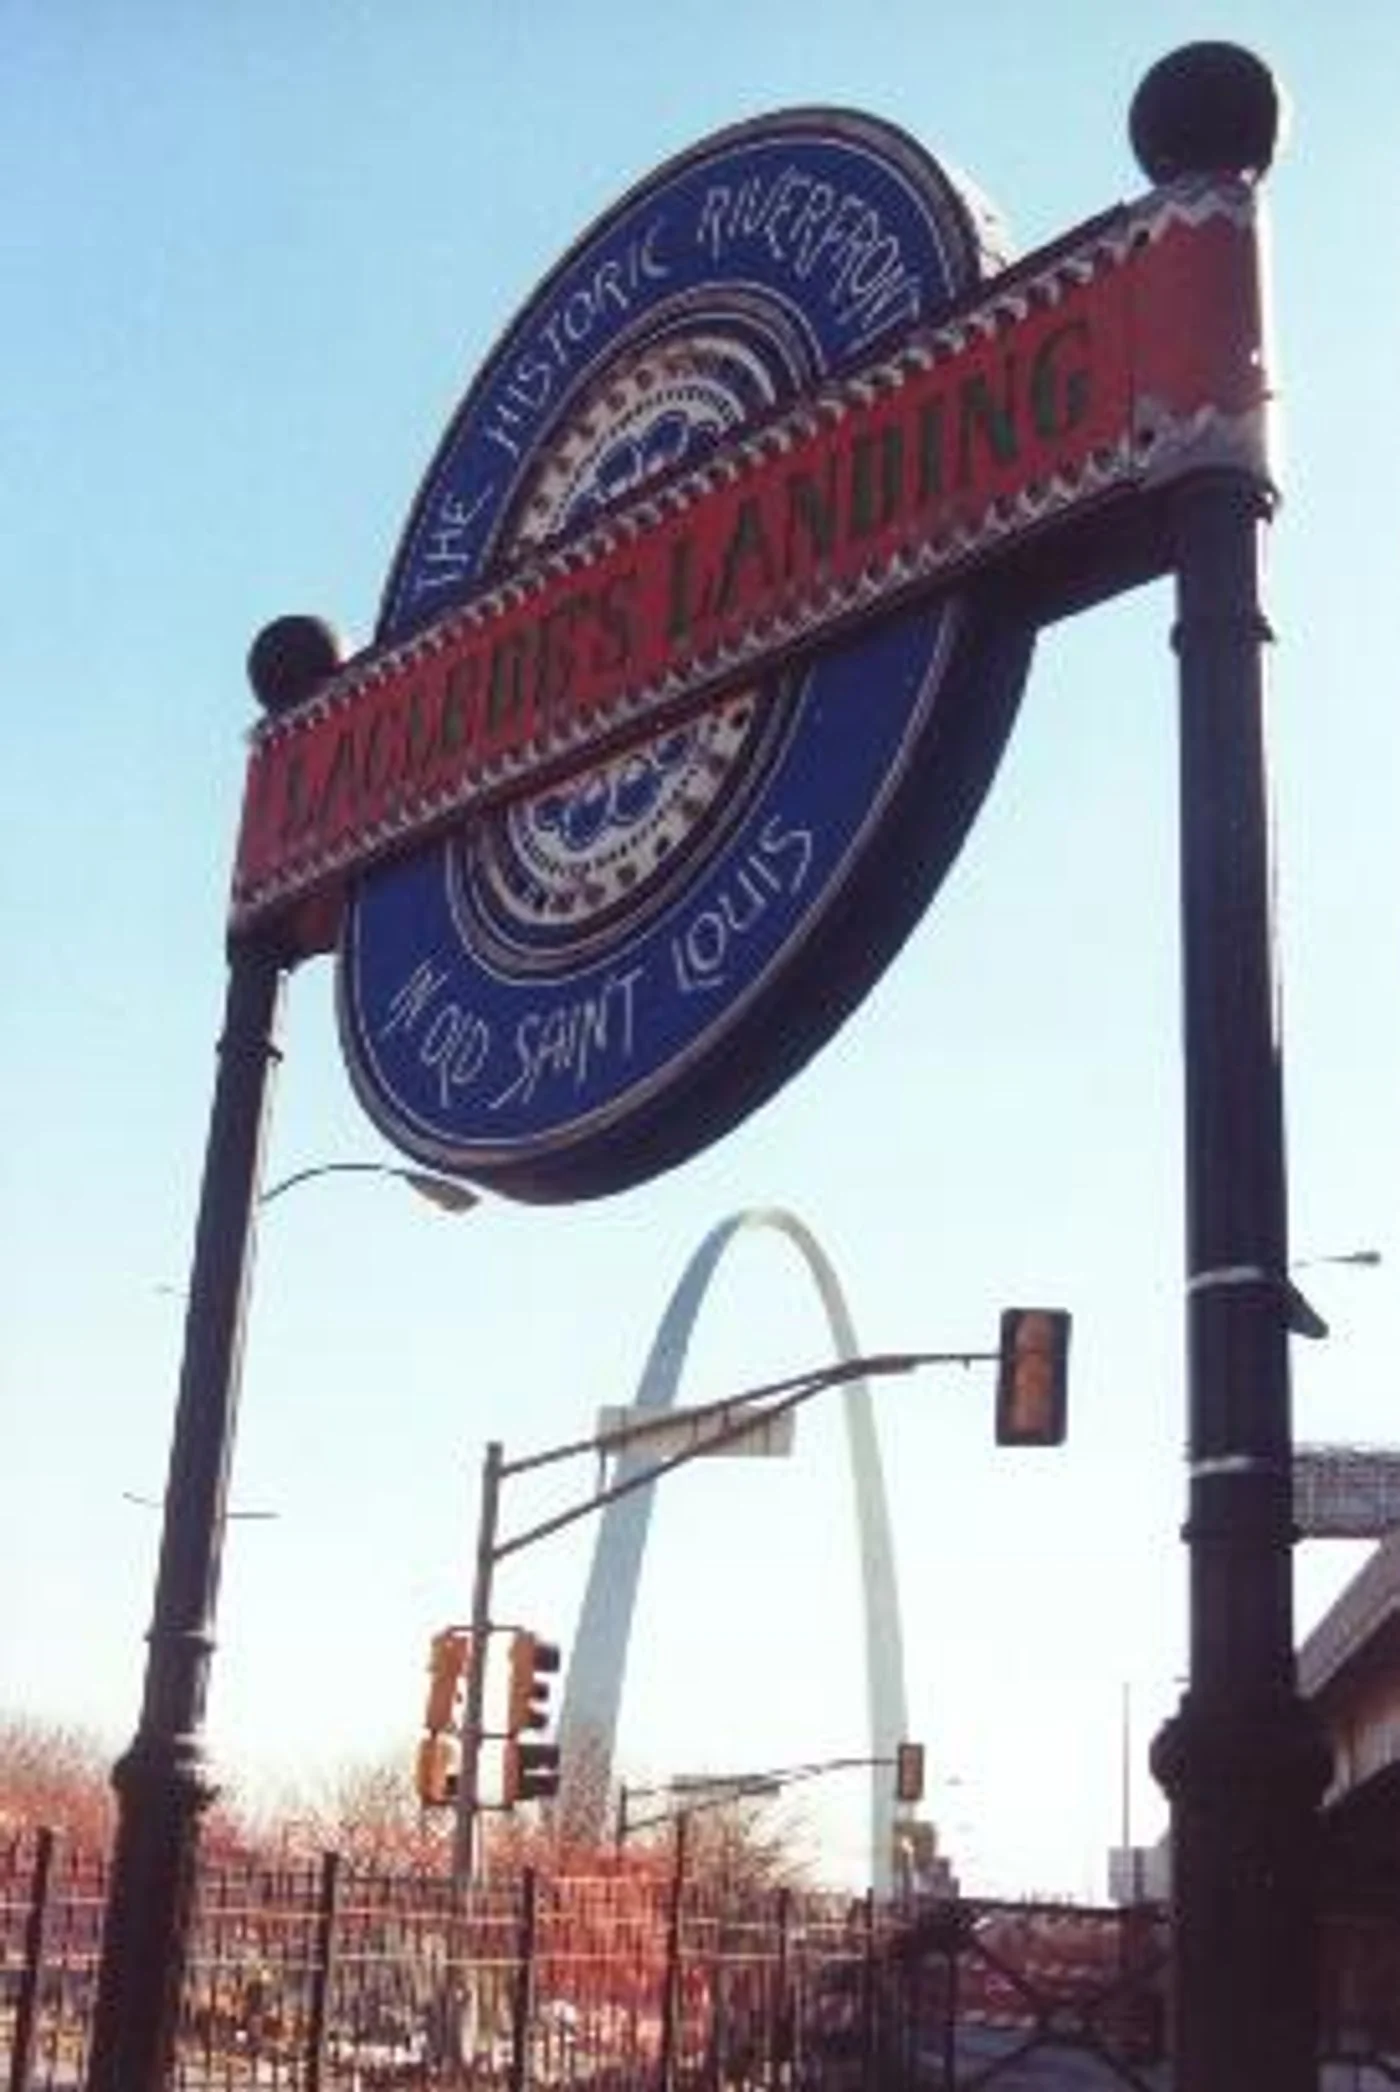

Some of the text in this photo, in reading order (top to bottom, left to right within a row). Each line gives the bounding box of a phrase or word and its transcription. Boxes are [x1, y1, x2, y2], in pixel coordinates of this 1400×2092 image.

[417, 164, 921, 596] THE HISTORIC RIVERFRONT
[665, 315, 1092, 645] LANDING
[379, 814, 813, 1110] IN OLD SAINT LOUIS
